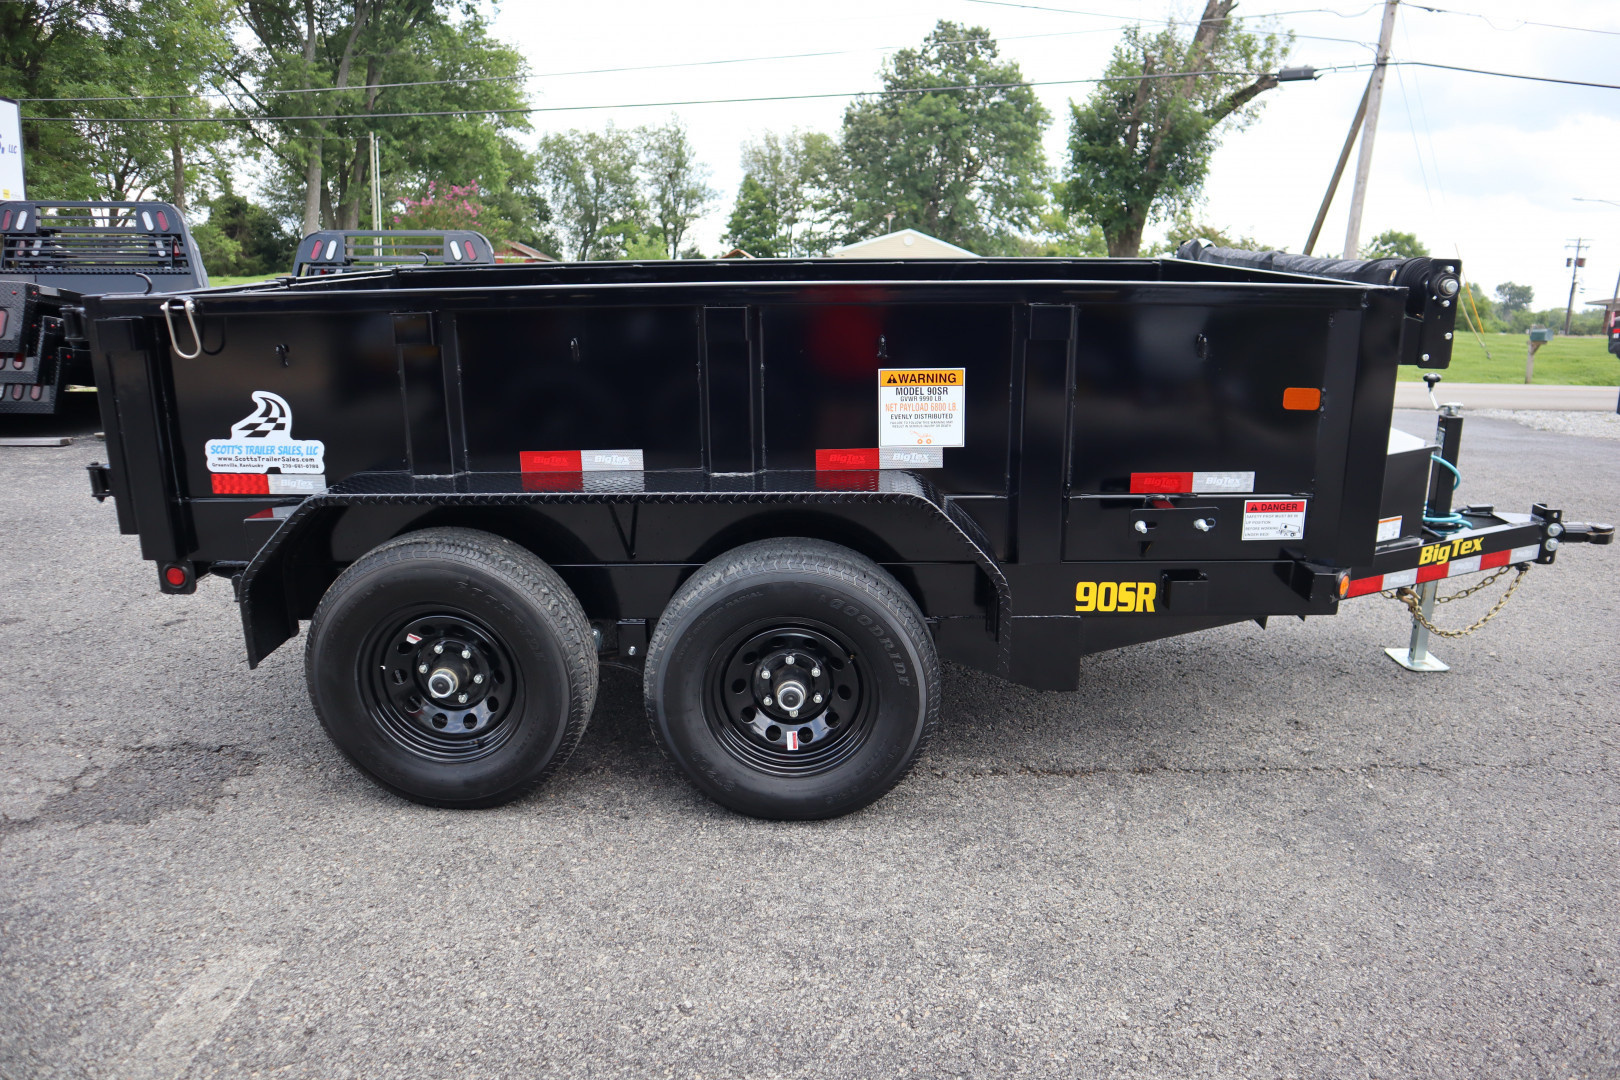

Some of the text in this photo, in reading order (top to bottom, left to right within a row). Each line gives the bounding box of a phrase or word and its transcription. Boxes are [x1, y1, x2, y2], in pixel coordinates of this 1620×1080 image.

[898, 373, 957, 384] WARNING
[895, 386, 949, 396] MODEL 90SR
[885, 403, 897, 412] NET
[899, 403, 929, 412] PAYLOAD
[930, 402, 947, 411] 6800
[210, 445, 318, 456] SCOTT'S TRAILER SALES, LLC
[1075, 581, 1157, 612] 90SR
